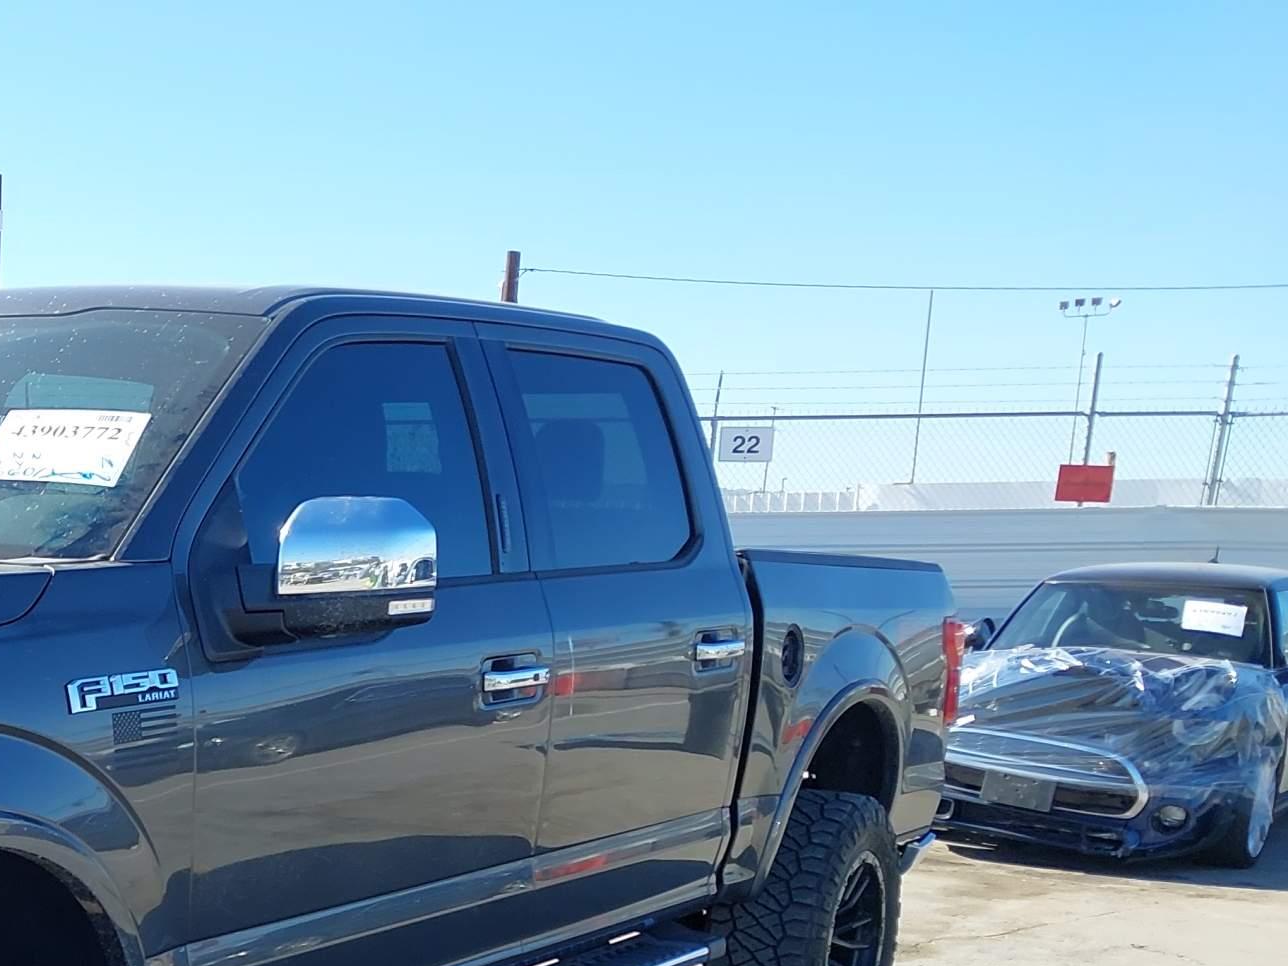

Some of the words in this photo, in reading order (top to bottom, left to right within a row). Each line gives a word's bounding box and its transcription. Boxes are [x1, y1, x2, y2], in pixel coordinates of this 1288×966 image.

[11, 424, 123, 441] 43903772
[731, 435, 761, 454] 22
[138, 689, 177, 703] LARIAT
